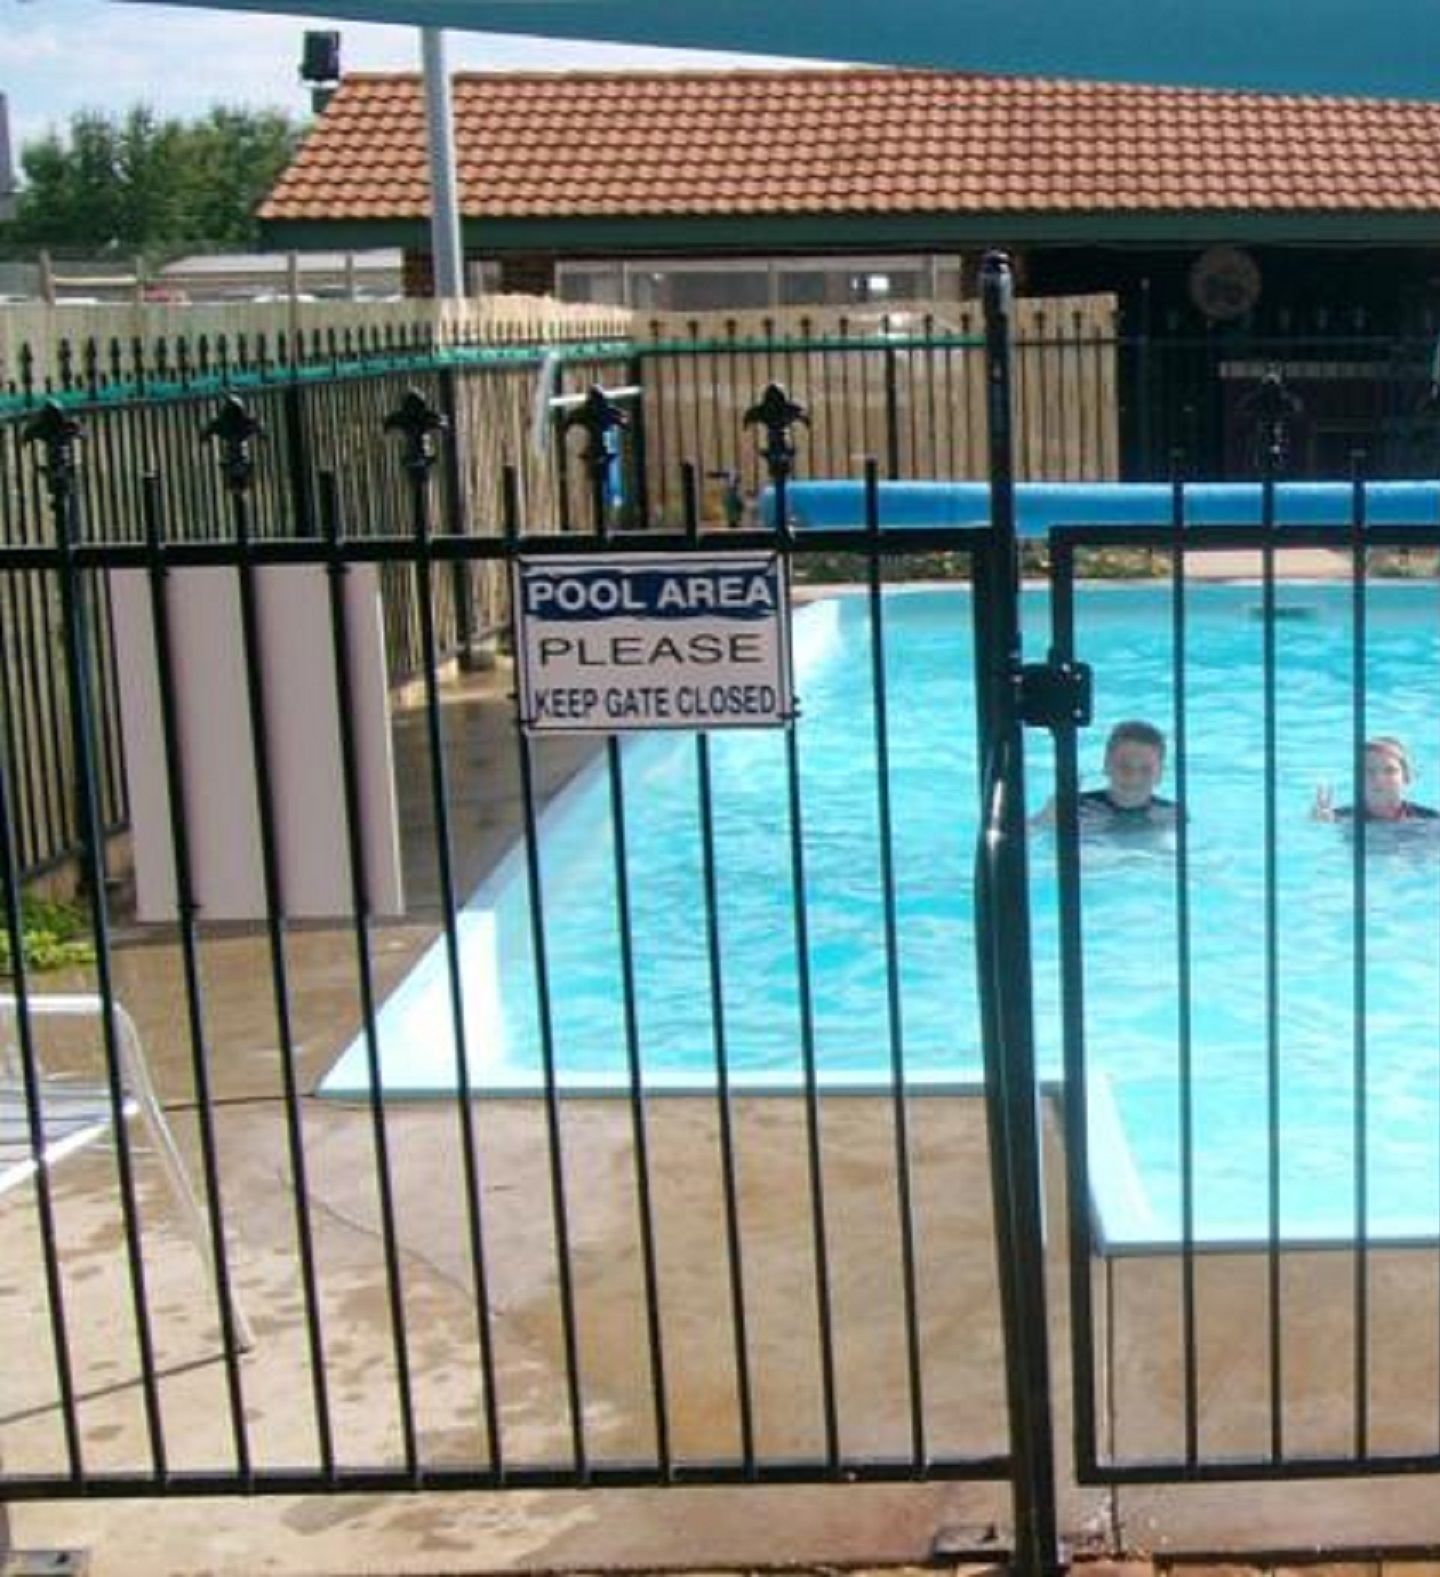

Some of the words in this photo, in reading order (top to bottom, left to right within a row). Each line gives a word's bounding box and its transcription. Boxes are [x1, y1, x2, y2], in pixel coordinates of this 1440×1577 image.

[527, 577, 647, 611] POOL
[656, 576, 774, 609] AREA
[540, 633, 765, 666] PLEASE
[535, 687, 599, 718] KEEP
[605, 687, 669, 718] GATE
[677, 685, 776, 716] CLOSED
